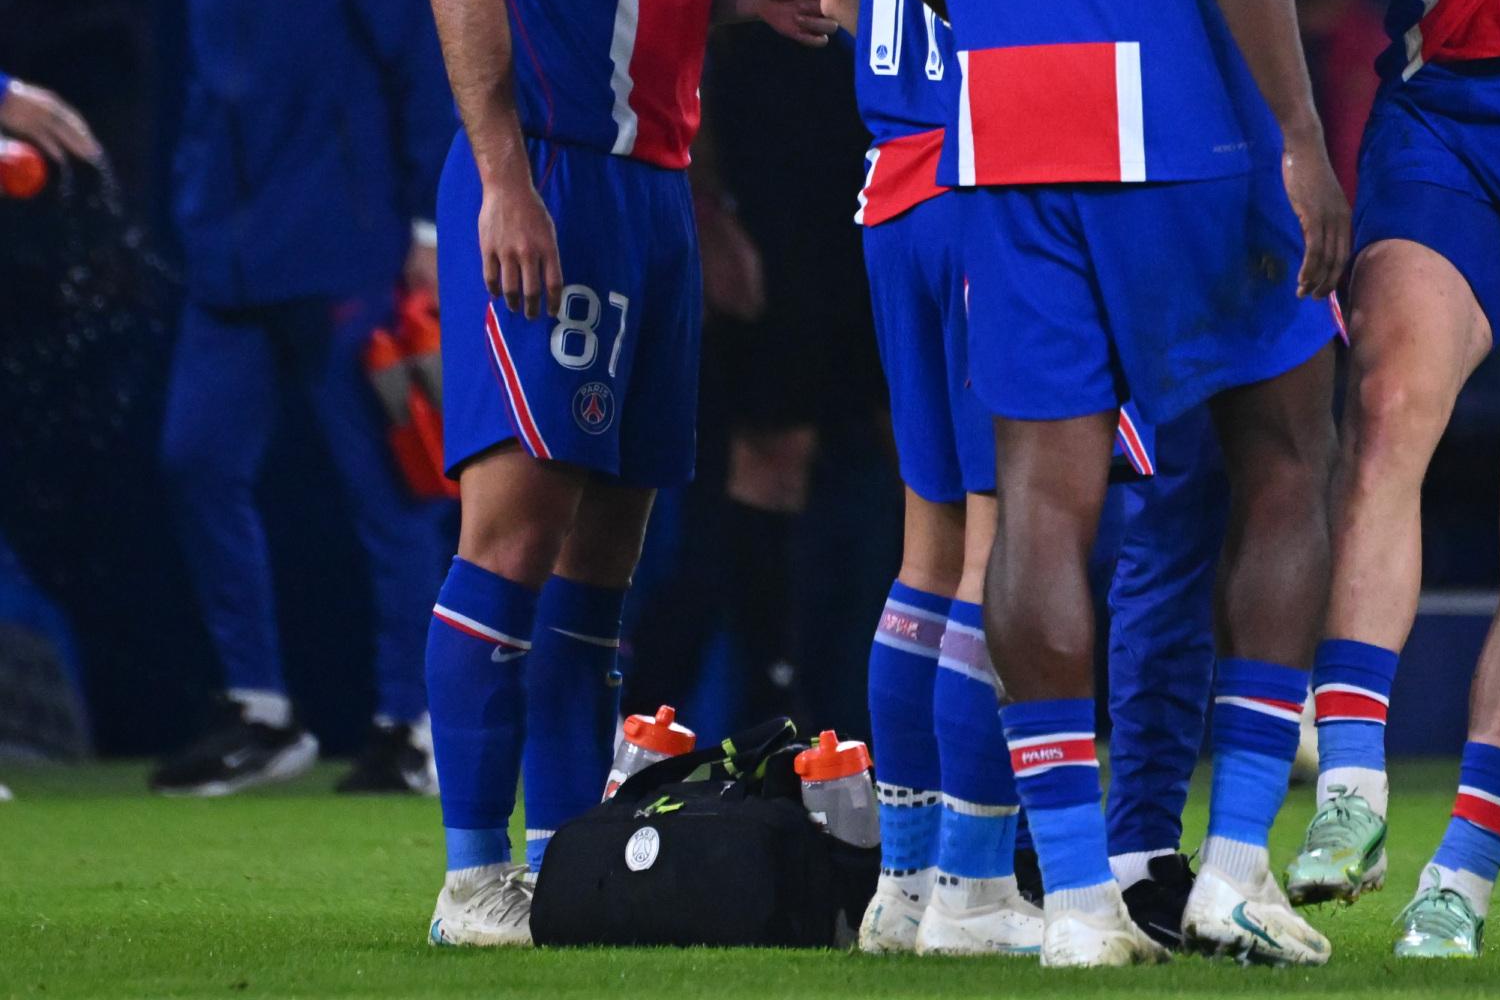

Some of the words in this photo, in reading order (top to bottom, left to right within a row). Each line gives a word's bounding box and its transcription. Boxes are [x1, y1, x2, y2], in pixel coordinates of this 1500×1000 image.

[551, 284, 629, 377] 87
[580, 385, 608, 398] PARIS
[1022, 747, 1063, 764] PARIS
